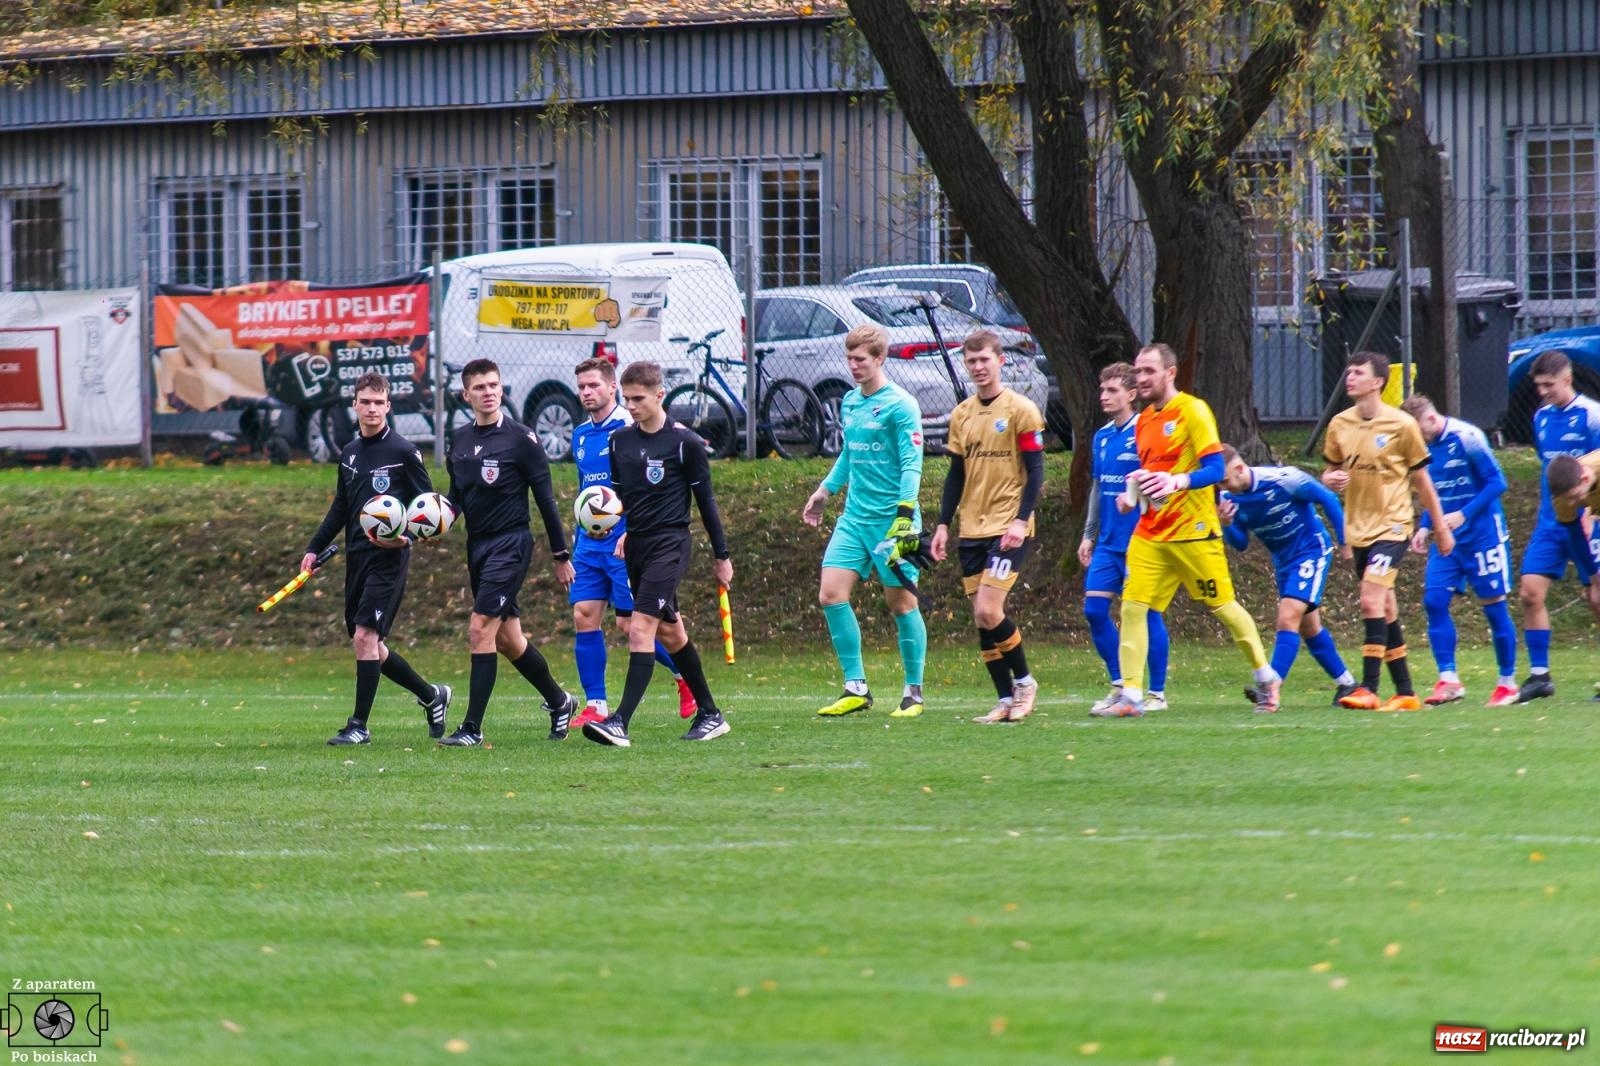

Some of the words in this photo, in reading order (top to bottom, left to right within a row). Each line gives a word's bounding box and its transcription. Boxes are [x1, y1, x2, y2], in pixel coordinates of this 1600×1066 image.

[488, 285, 533, 298] URODZINKI
[536, 287, 548, 298] NA
[551, 287, 600, 299] SPORTOWO
[237, 300, 321, 323] BRYKIET
[325, 299, 332, 319] I
[337, 293, 416, 318] PELLET
[515, 302, 568, 315] 797-817-117
[336, 348, 359, 361] 537
[361, 346, 384, 360] 573
[386, 344, 411, 358] 815
[339, 366, 364, 380] 600
[392, 362, 415, 376] 639
[391, 381, 415, 395] 125
[990, 556, 1012, 580] 10
[1299, 558, 1314, 579] 6
[1370, 553, 1392, 576] 21
[1474, 548, 1501, 576] 15
